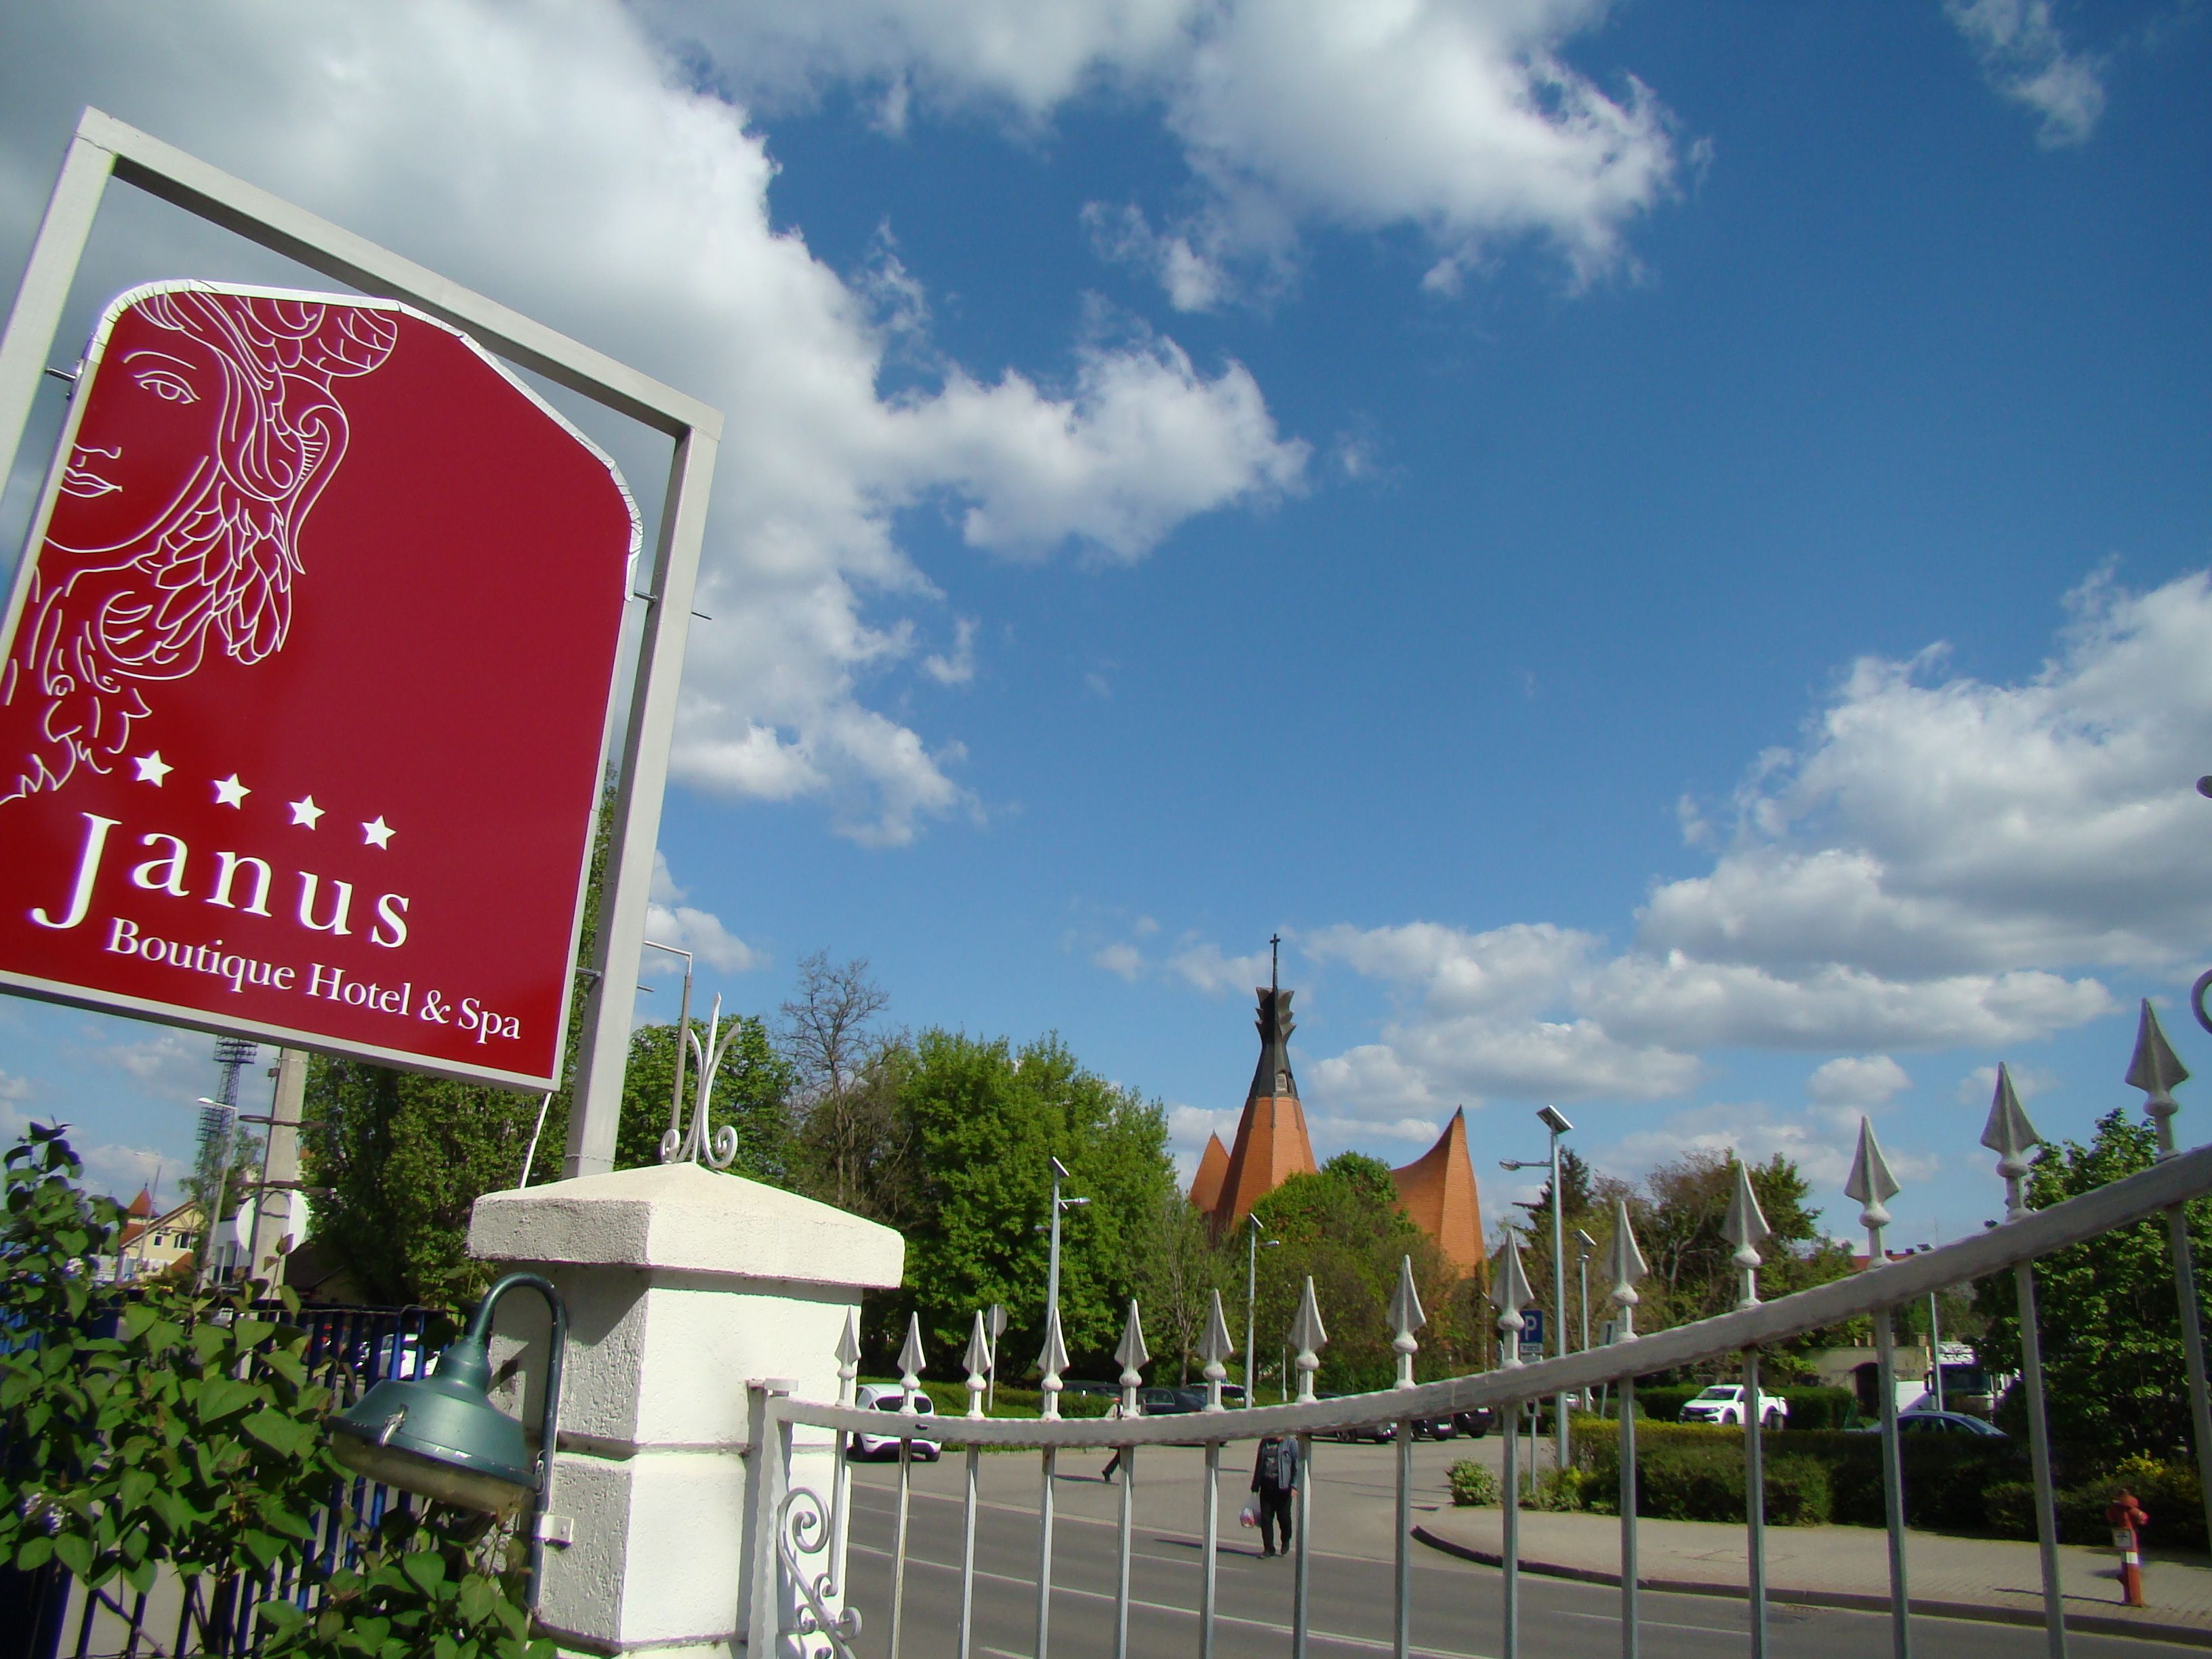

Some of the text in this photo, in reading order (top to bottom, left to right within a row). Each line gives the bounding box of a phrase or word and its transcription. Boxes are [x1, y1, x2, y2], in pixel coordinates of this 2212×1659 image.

[30, 811, 410, 949] Janus
[106, 917, 521, 1044] Boutique Hotel & Spa
[1525, 1315, 1537, 1341] P
